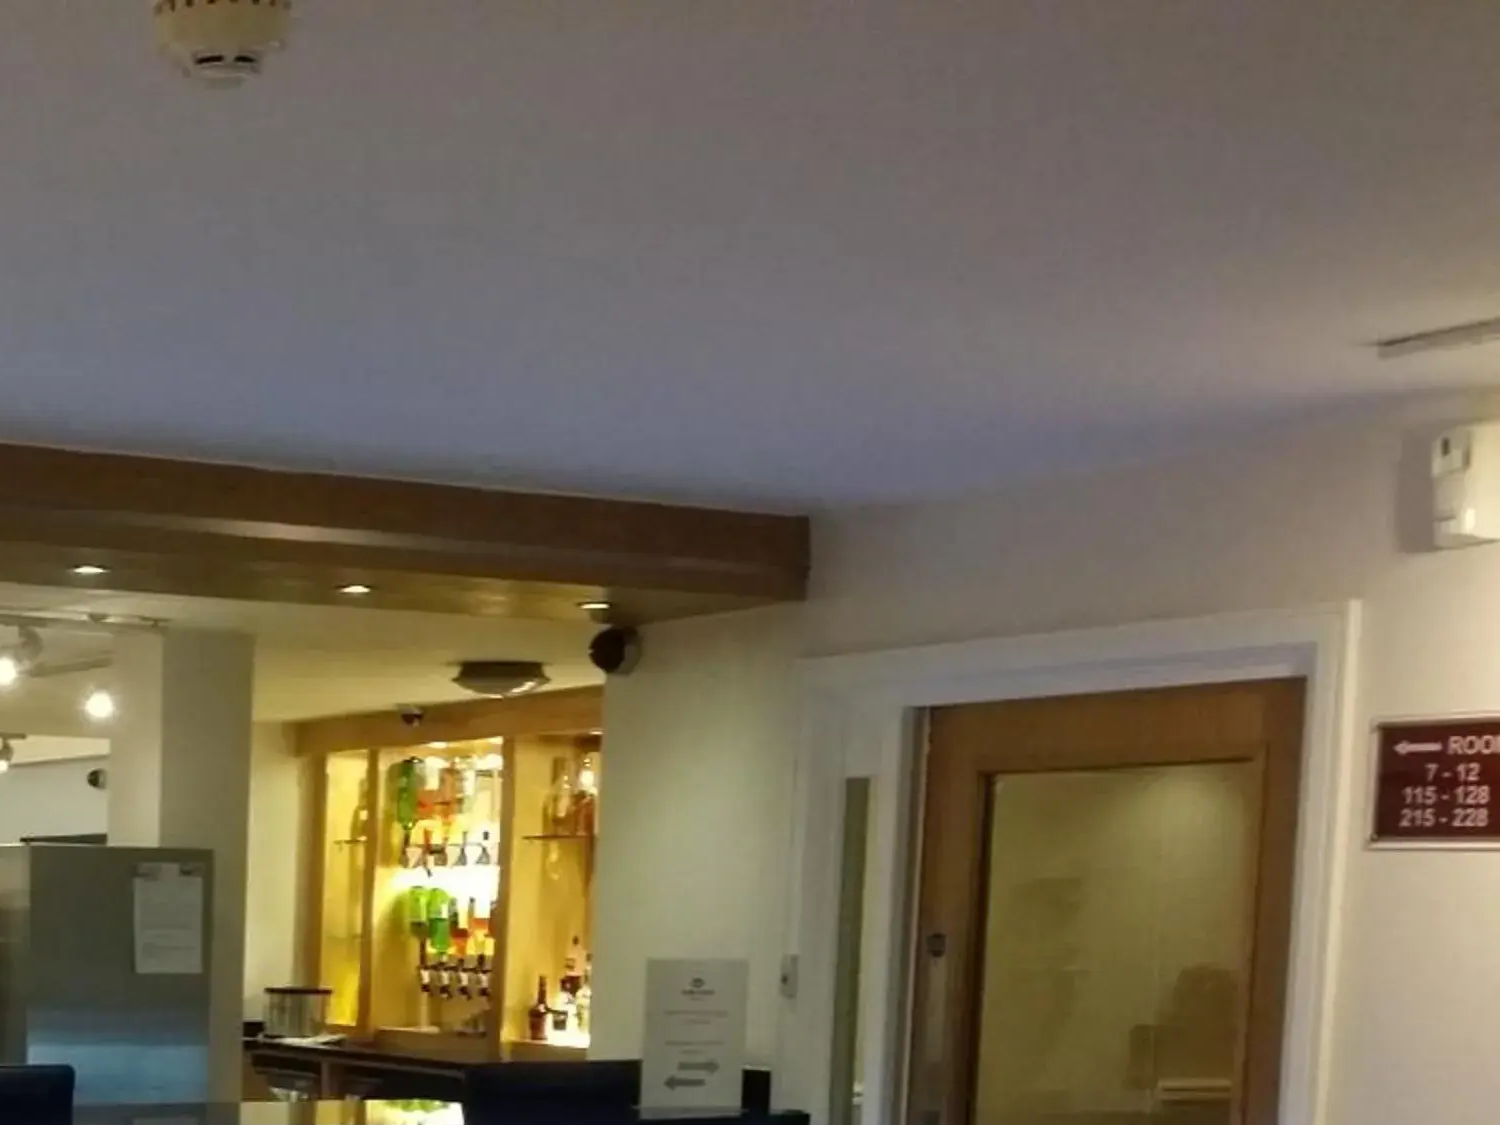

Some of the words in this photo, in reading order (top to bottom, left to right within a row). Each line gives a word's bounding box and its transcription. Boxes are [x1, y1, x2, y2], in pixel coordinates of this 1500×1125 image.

[1447, 735, 1500, 754] ROO
[1425, 763, 1439, 781] 7
[1456, 762, 1480, 781] 12
[1402, 785, 1437, 804] 115
[1453, 785, 1490, 804] 128
[1399, 807, 1436, 827] 215
[1451, 807, 1488, 827] 228
